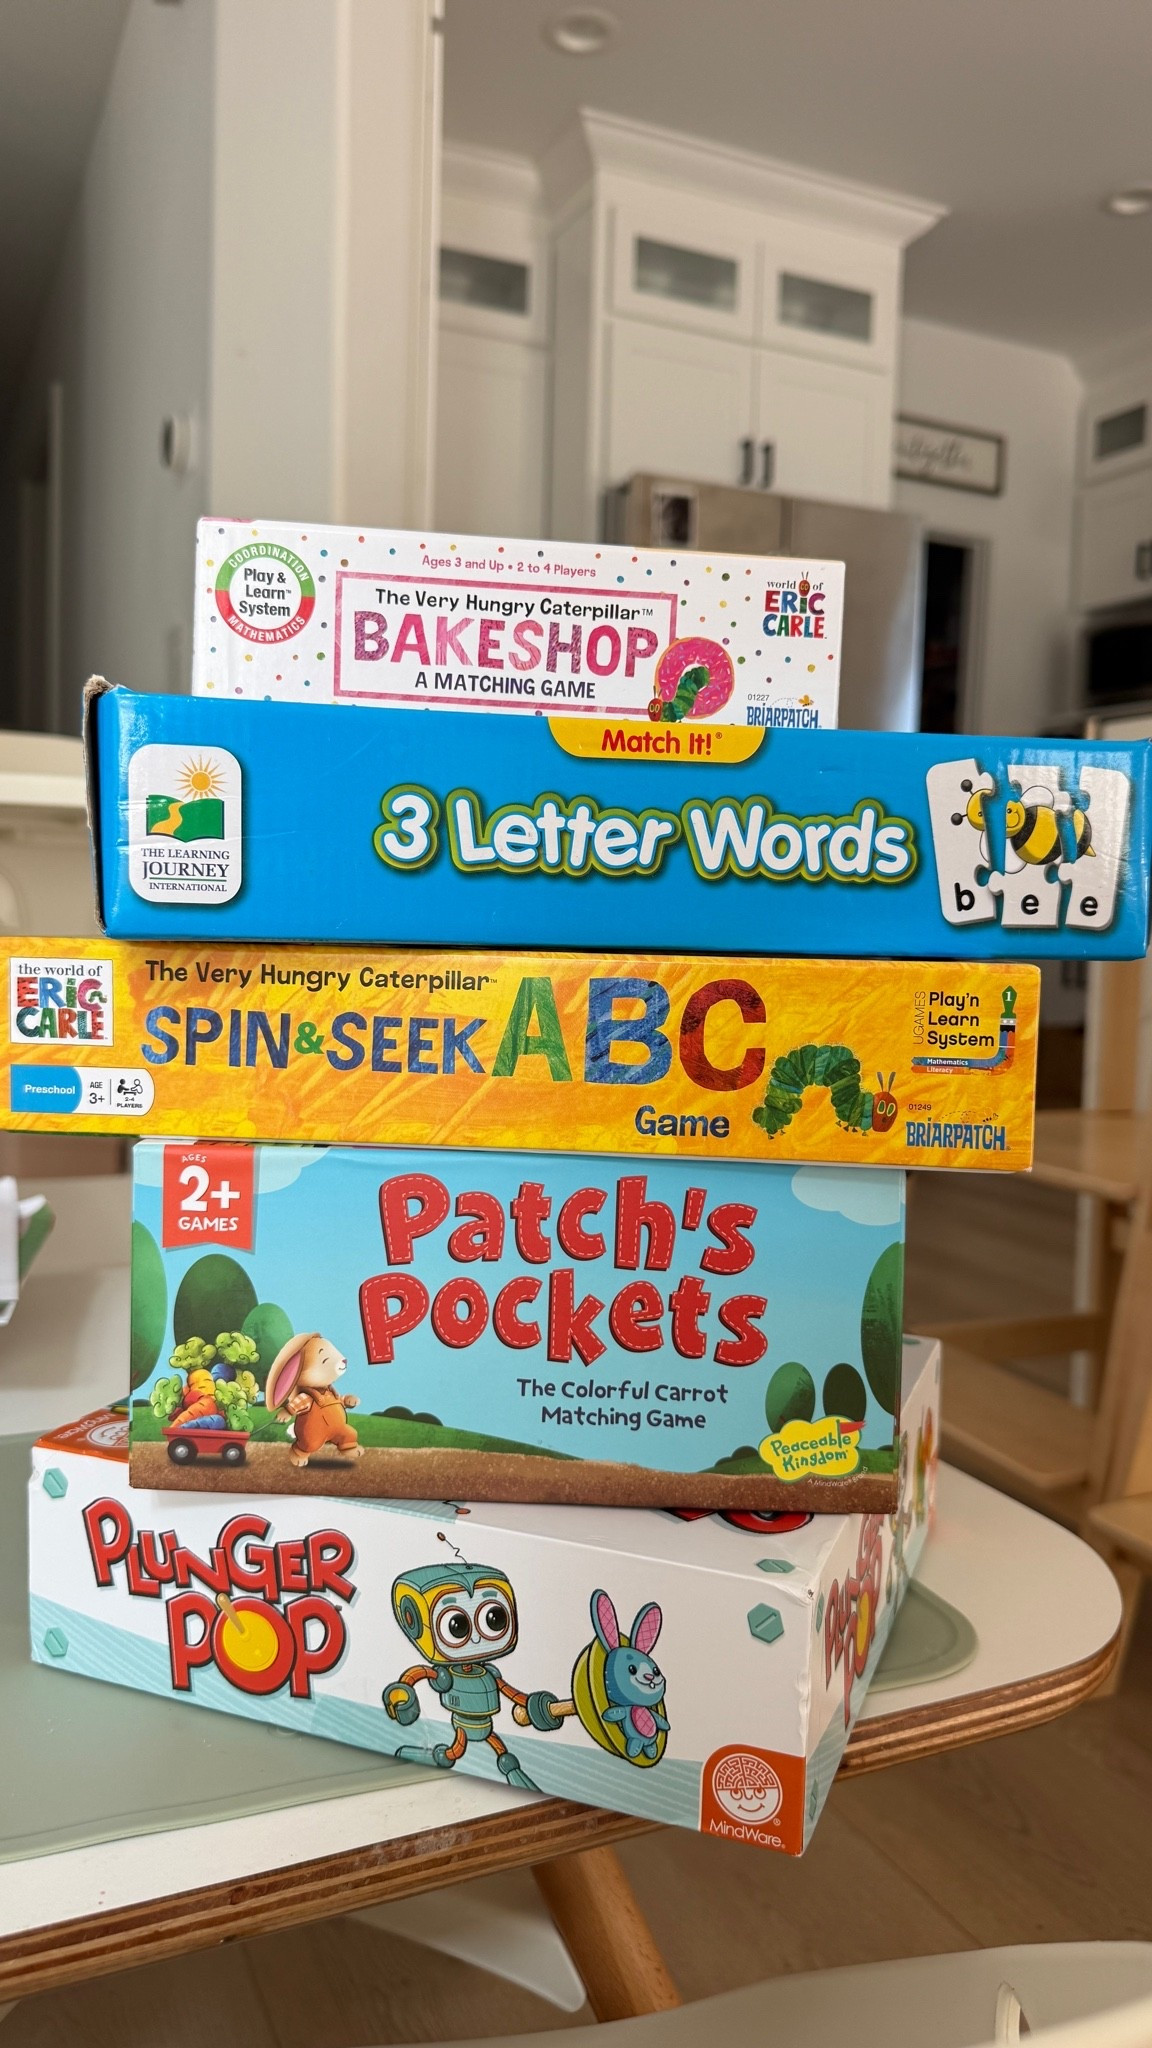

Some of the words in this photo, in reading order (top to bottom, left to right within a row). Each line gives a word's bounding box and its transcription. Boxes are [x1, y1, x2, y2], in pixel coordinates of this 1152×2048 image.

[228, 544, 310, 583] COORDINATION
[422, 555, 451, 570] Ages
[455, 557, 462, 567] 3
[464, 558, 486, 568] and
[488, 559, 504, 571] Up
[517, 562, 525, 573] 2
[527, 563, 540, 574] to
[543, 563, 551, 574] 4
[553, 564, 596, 578] Players
[244, 568, 274, 585] Play
[277, 571, 286, 583] &
[767, 580, 796, 590] world
[812, 582, 824, 591] of
[239, 601, 290, 617] System
[376, 588, 410, 606] The
[415, 590, 459, 612] Very
[466, 594, 533, 617] Hungry
[228, 614, 305, 642] MATHEMATICS
[762, 613, 825, 639] CARLE
[354, 610, 658, 678] BAKESHOP
[415, 671, 428, 689] A
[434, 673, 535, 695] MATCHING
[541, 679, 595, 699] GAME
[601, 729, 680, 754] Match
[378, 789, 434, 865] 3
[451, 794, 677, 872] Letter
[686, 800, 912, 878] Words
[141, 848, 165, 858] THE
[168, 849, 230, 860] LEARNING
[142, 861, 230, 880] JOURNEY
[149, 882, 227, 892] INTERNATIONAL
[18, 963, 41, 975] the
[44, 964, 84, 976] world
[88, 965, 102, 976] of
[145, 960, 188, 982] The
[196, 962, 252, 989] Very
[260, 964, 350, 992] Hungry
[929, 991, 979, 1011] Play'n
[1005, 991, 1012, 1001] 1
[16, 1007, 104, 1040] CARLE
[913, 991, 926, 1044] UGAMES
[928, 1011, 979, 1027] Learn
[491, 976, 766, 1092] ABC
[927, 1030, 994, 1049] System
[927, 1058, 968, 1066] Mathematics
[927, 1066, 953, 1074] Literacy
[25, 1084, 75, 1095] Preschool
[89, 1093, 105, 1104] 3+
[634, 1104, 730, 1139] Game
[181, 1153, 207, 1163] AGES
[178, 1165, 241, 1212] 2+
[178, 1216, 239, 1232] GAMES
[379, 1173, 758, 1275] Patch's
[359, 1268, 768, 1367] Pockets
[516, 1378, 556, 1397] The
[561, 1380, 649, 1400] Colorful
[655, 1384, 728, 1403] Carrot
[541, 1406, 641, 1431] Matching
[646, 1410, 706, 1429] Game
[770, 1420, 851, 1456] Peaceable
[782, 1451, 847, 1472] Kingdom
[82, 1496, 357, 1604] PLUNGER
[825, 1512, 884, 1692] PLUNGE
[166, 1591, 347, 1699] POP
